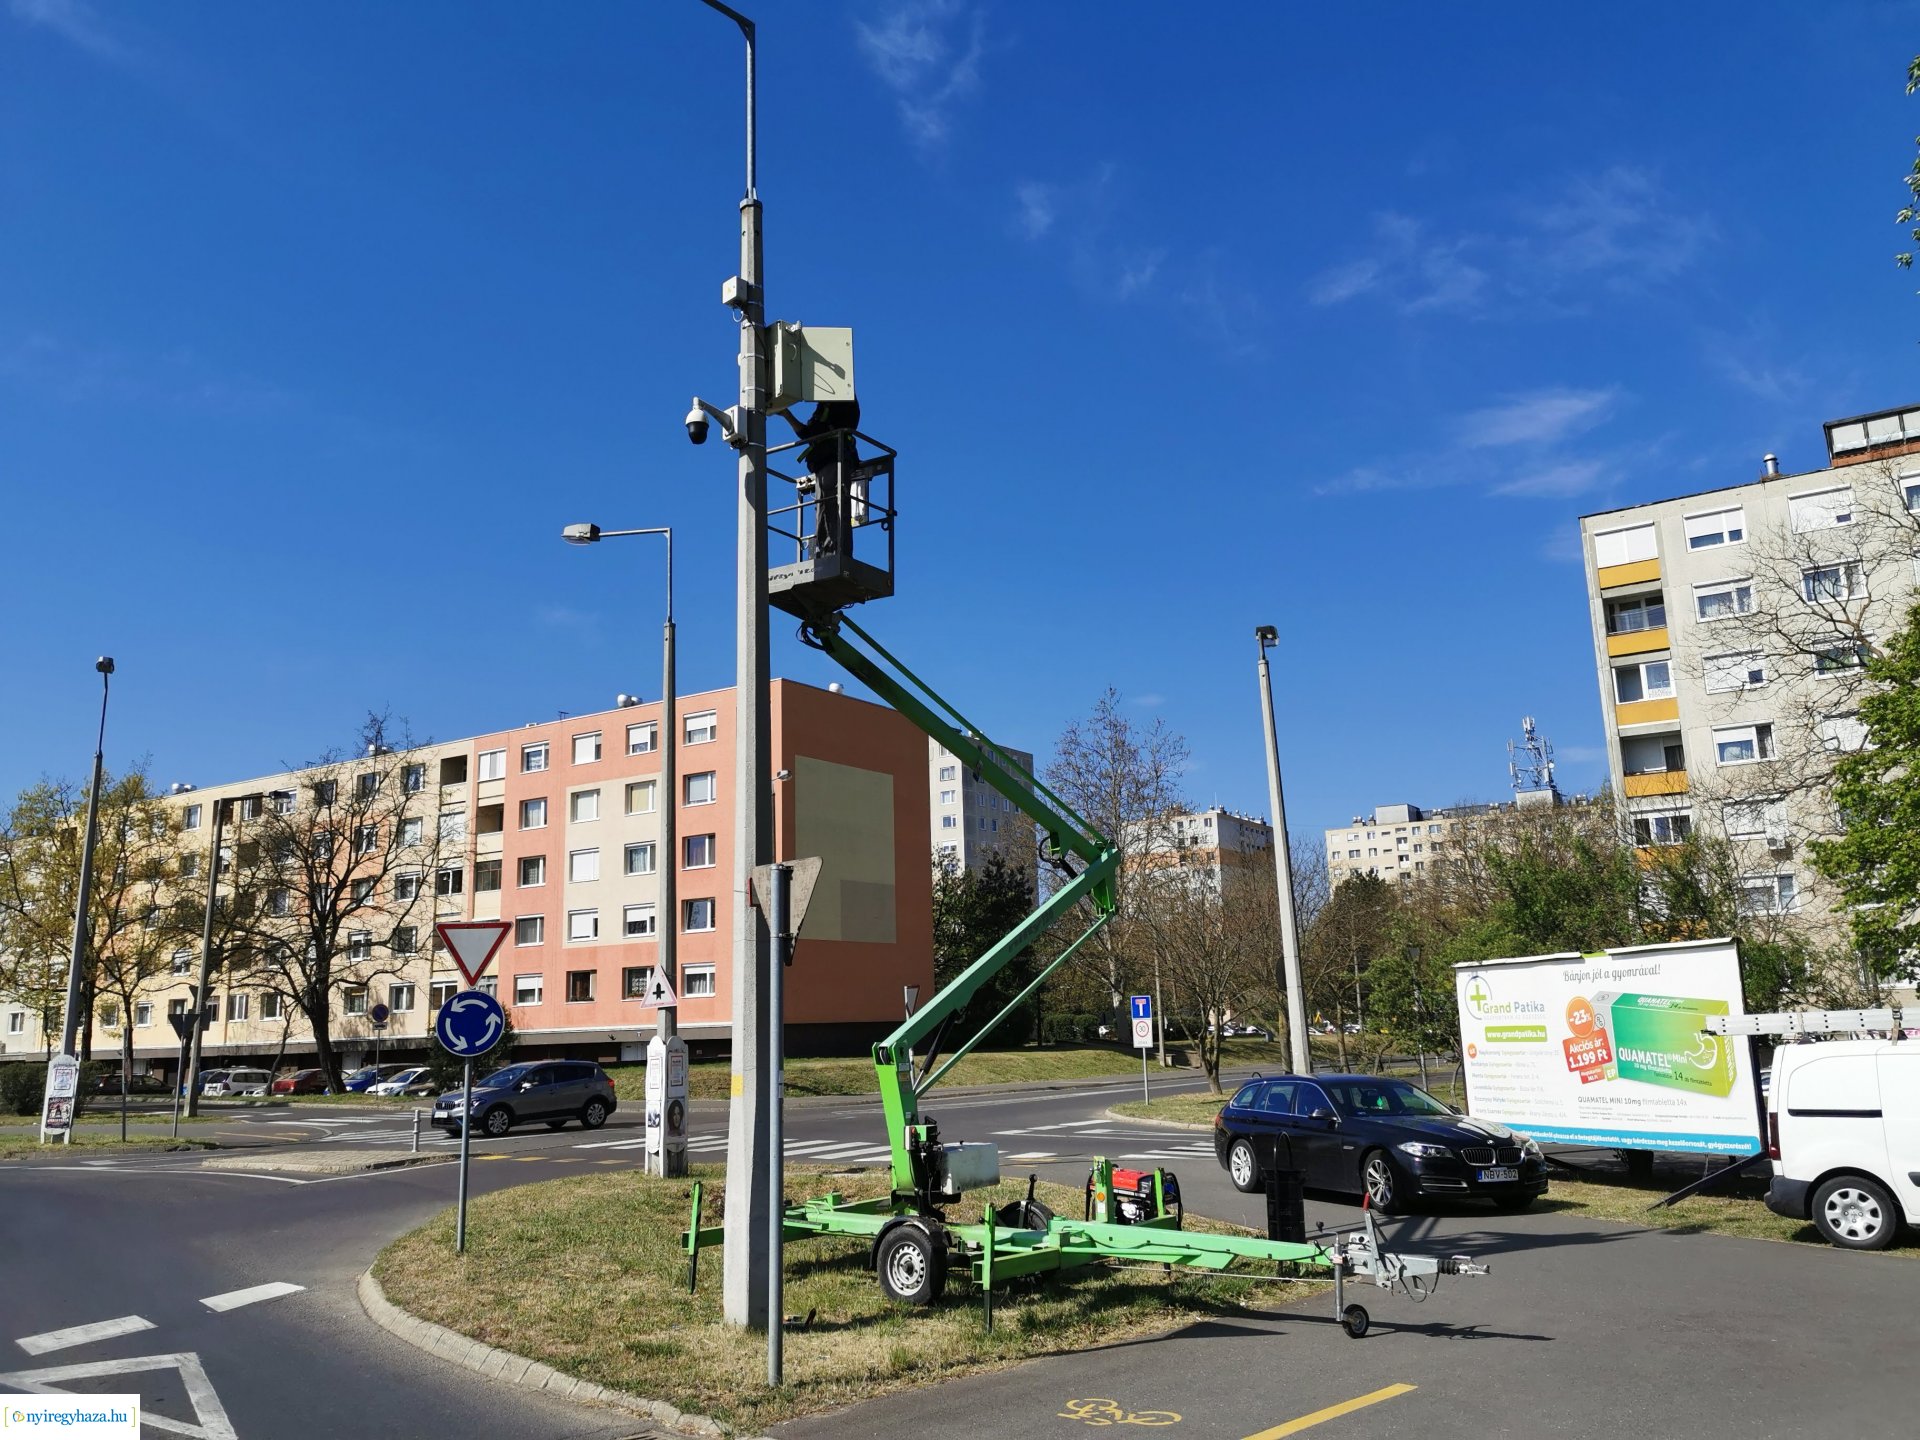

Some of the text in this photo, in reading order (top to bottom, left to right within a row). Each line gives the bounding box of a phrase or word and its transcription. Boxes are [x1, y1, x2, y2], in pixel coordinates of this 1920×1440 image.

[1563, 964, 1661, 984] Bánjon jól a gyomrával!
[1482, 1001, 1545, 1014] Grand Patika
[1486, 1029, 1545, 1039] www.grandpatika.hu
[1569, 1040, 1594, 1054] Akciós
[1569, 1049, 1609, 1069] 1.199 Ft
[1674, 1071, 1683, 1081] 14
[1578, 1096, 1609, 1104] QUAMATEL
[1609, 1097, 1623, 1105] MINI
[1624, 1098, 1642, 1106] 10mg
[1676, 1098, 1688, 1106] 14x
[1483, 1169, 1518, 1180] NBV-502
